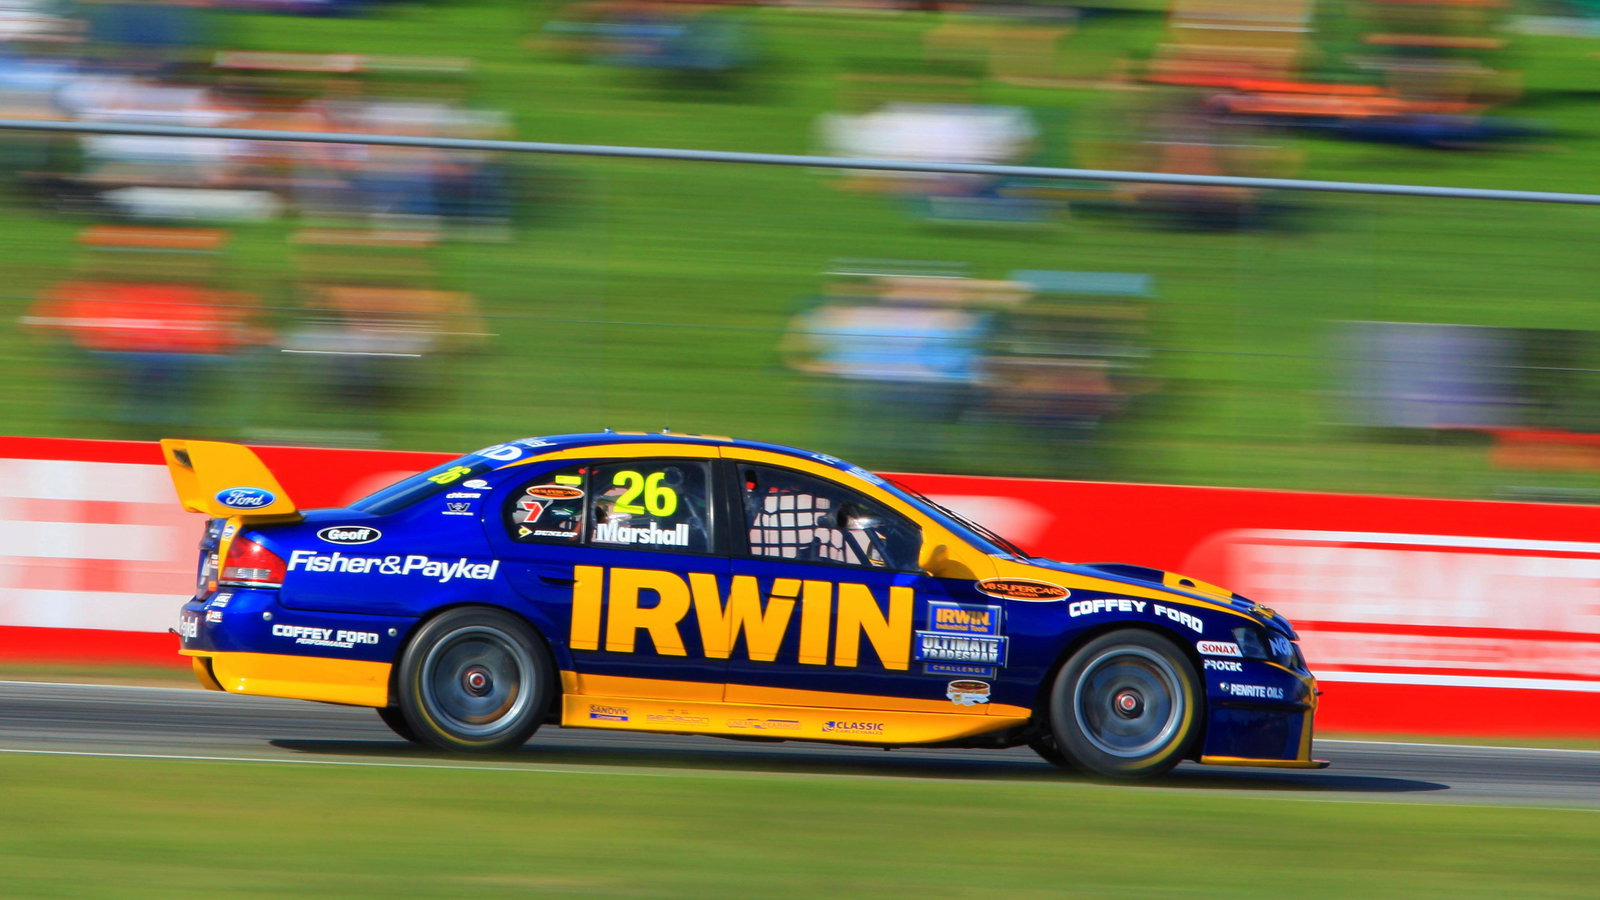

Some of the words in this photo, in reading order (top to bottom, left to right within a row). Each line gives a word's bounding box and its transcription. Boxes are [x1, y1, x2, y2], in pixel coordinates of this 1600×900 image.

[428, 466, 472, 485] 26
[225, 490, 264, 505] Ford
[612, 471, 677, 517] 26
[327, 529, 371, 541] Geoff
[533, 530, 578, 538] DUNLOP
[596, 522, 689, 546] Marshall
[287, 550, 500, 583] Fisher&Paykel
[997, 583, 1066, 597] SUPERCARS
[569, 564, 914, 671] IRWIN
[936, 608, 991, 626] IRWIN
[1068, 598, 1147, 618] COFFEY
[1153, 603, 1204, 634] FORD
[272, 624, 333, 641] COFFEY
[336, 630, 379, 645] FORD
[295, 637, 354, 649] PERFORMANCE
[921, 634, 999, 653] ULTIMATE
[1202, 643, 1237, 655] SONAX
[921, 648, 999, 663] TRADESMAN
[932, 664, 986, 673] CHALLENGE
[1204, 659, 1243, 672] PROTEC
[1230, 683, 1266, 698] PENRITE
[1266, 686, 1283, 699] OILS
[590, 704, 628, 715] SANDVIK
[836, 721, 884, 731] CLASSIC
